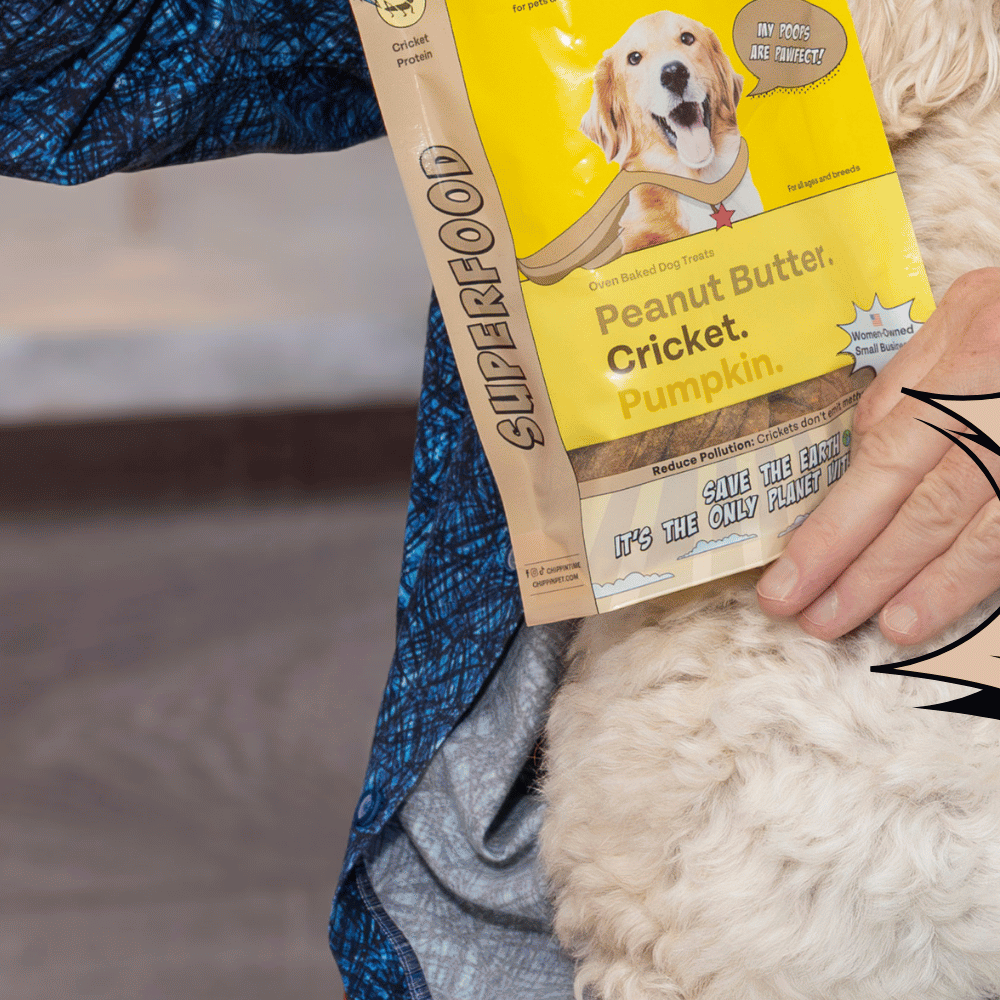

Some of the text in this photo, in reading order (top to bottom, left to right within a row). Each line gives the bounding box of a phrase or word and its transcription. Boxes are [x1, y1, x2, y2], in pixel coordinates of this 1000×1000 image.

[513, 4, 526, 13] for
[392, 34, 430, 53] Cricket
[757, 21, 811, 42] MY POOPS
[397, 50, 433, 68] Protein
[749, 44, 826, 66] ARE PAWFECT!
[819, 172, 832, 183] and
[832, 164, 861, 179] breeds
[588, 249, 715, 292] Oven Baked Dog Treats
[419, 145, 545, 450] SUPERFOOD
[595, 245, 834, 335] Peanut Butter.
[607, 314, 749, 375] Cricket.
[851, 324, 914, 341] Women-Owned
[855, 341, 907, 356] Small Busine
[617, 352, 783, 420] Pumpkin.
[652, 457, 697, 476] Reduce
[700, 438, 755, 462] Pollution:
[757, 422, 799, 444] Crickets
[801, 411, 826, 428] don't
[828, 402, 842, 418] emit
[702, 432, 841, 505] SAVE THE EARTH
[614, 526, 653, 559] IT'S
[661, 511, 699, 544] THE
[708, 494, 759, 529] ONLY
[767, 469, 821, 513] PLANET
